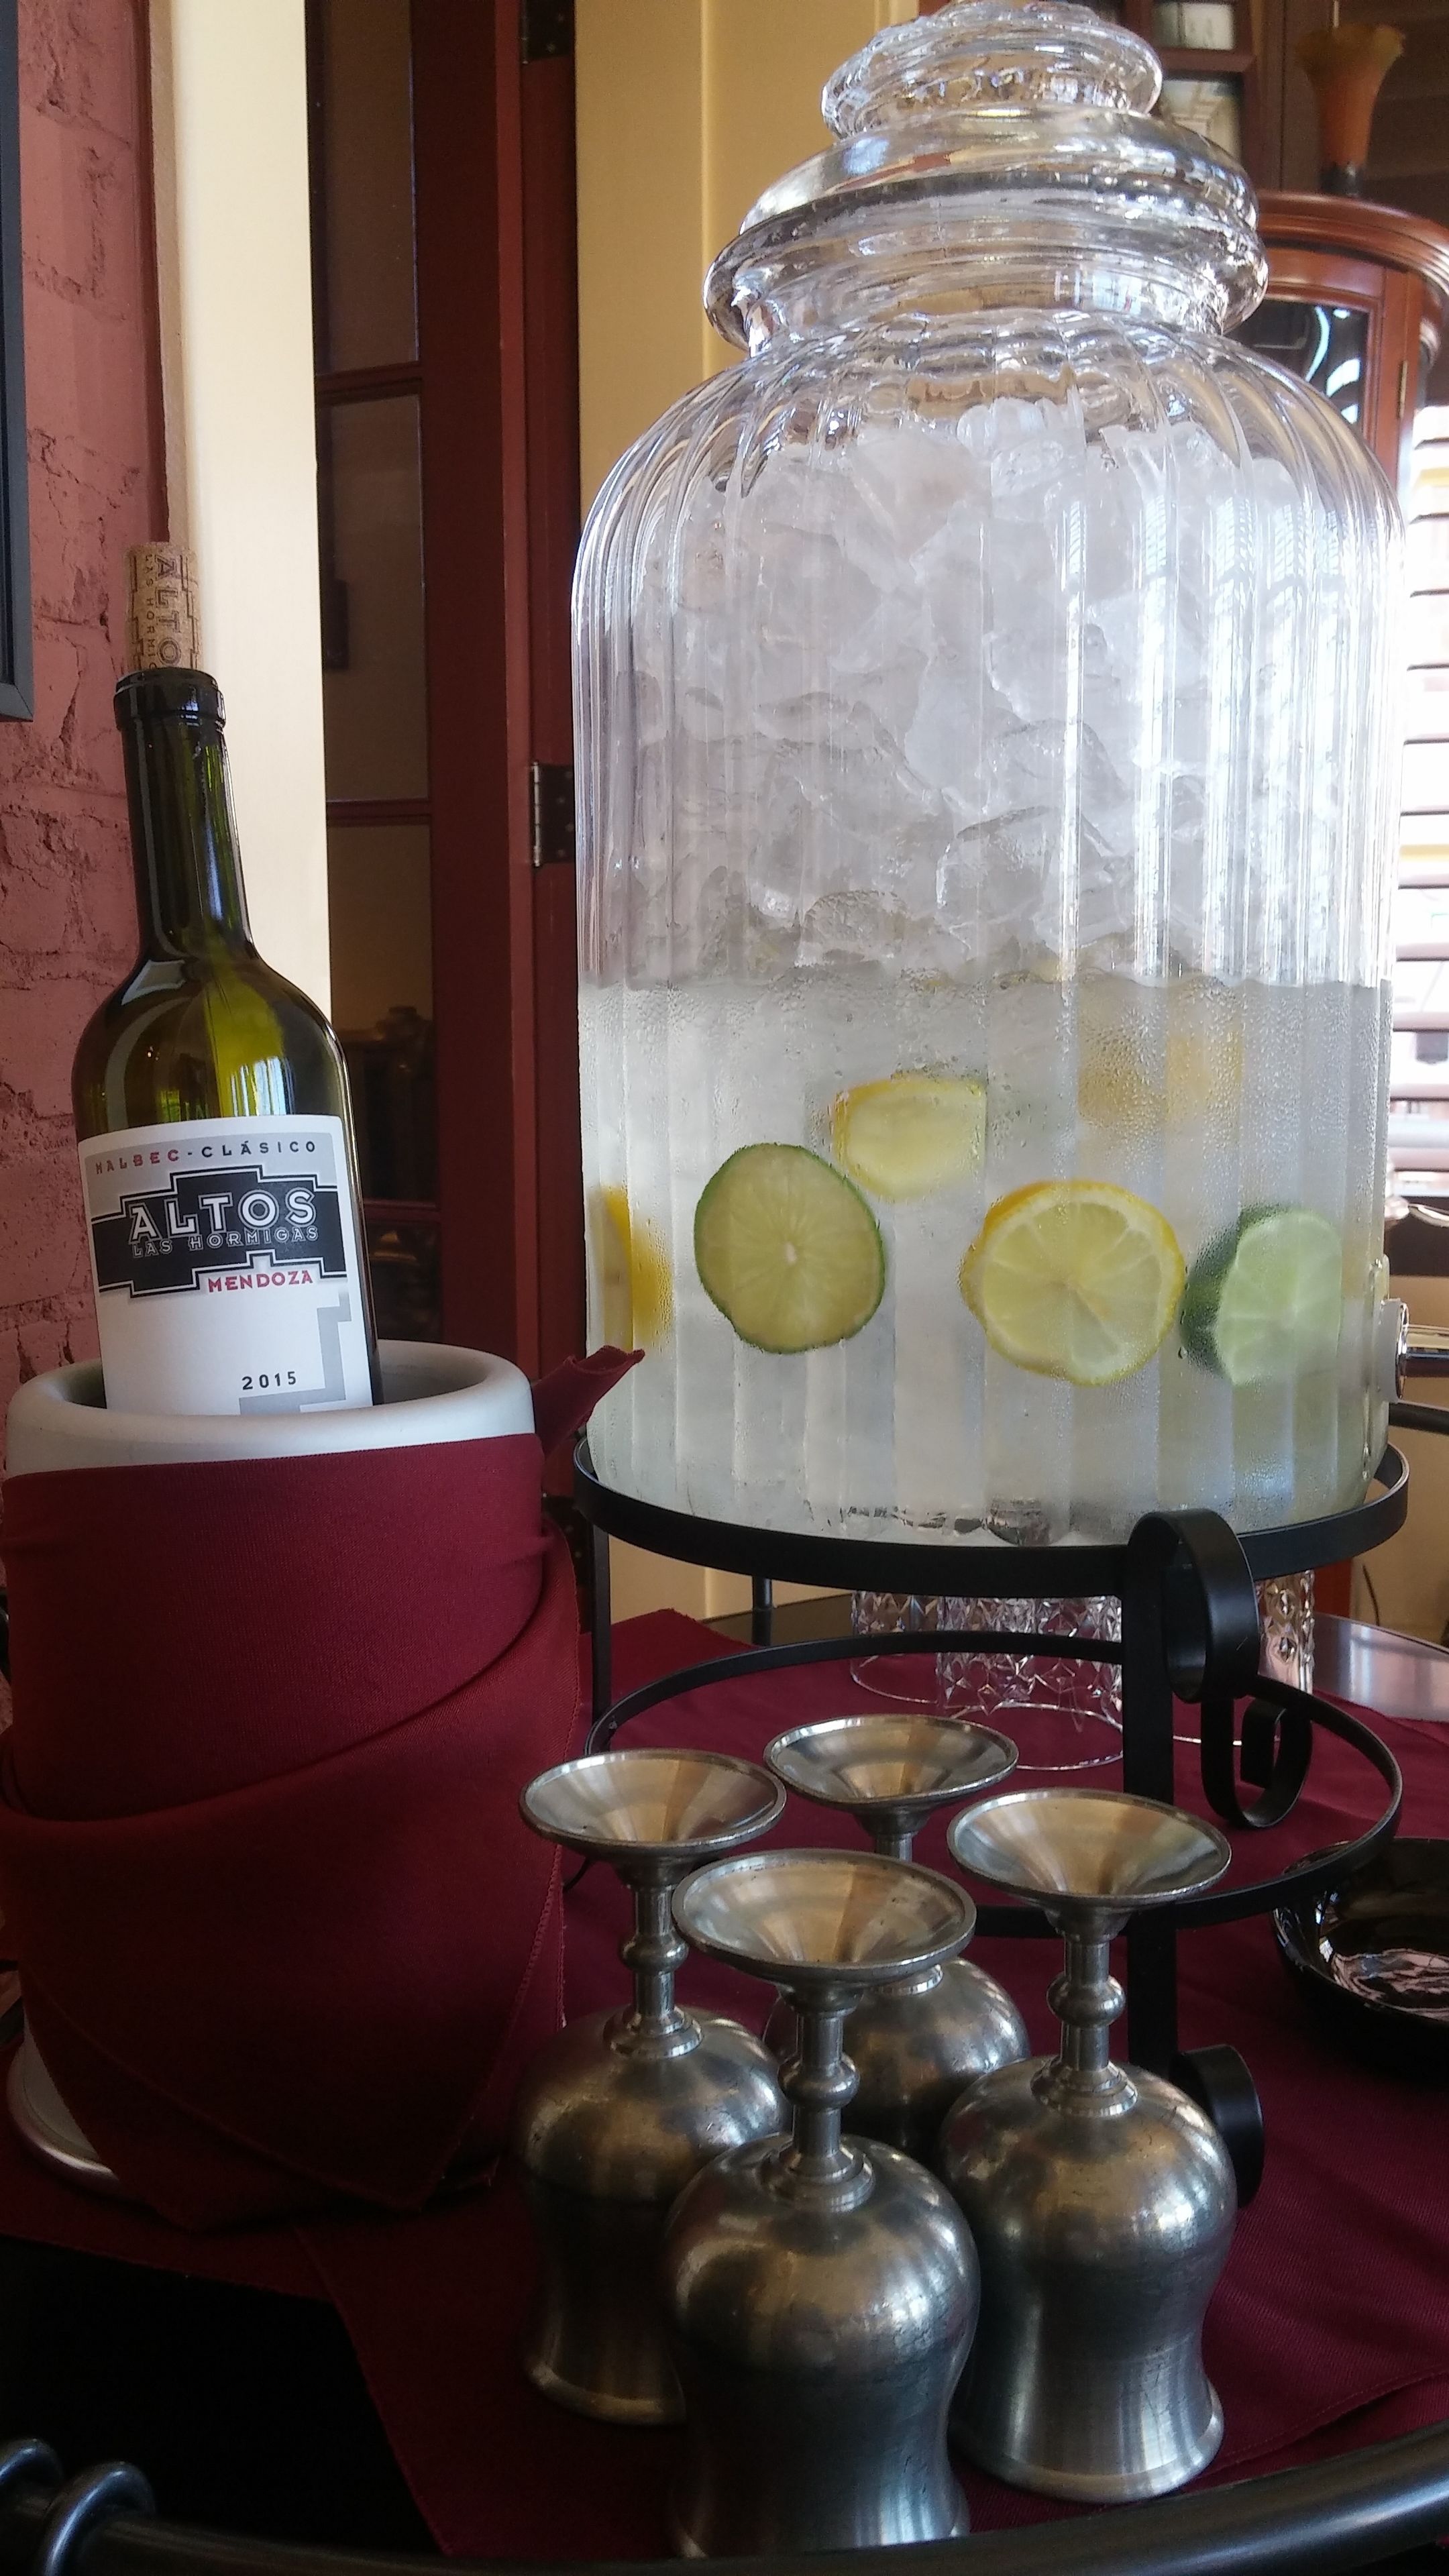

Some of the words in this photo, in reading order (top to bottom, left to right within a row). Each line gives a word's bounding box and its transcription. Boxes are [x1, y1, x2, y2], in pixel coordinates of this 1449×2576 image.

[145, 554, 154, 587] LAS
[129, 1187, 317, 1244] ALTOS
[133, 1239, 172, 1258] LAS
[189, 1226, 319, 1252] HORMIGAS
[208, 1270, 313, 1293] MENDOZA
[241, 1371, 297, 1391] 2015
